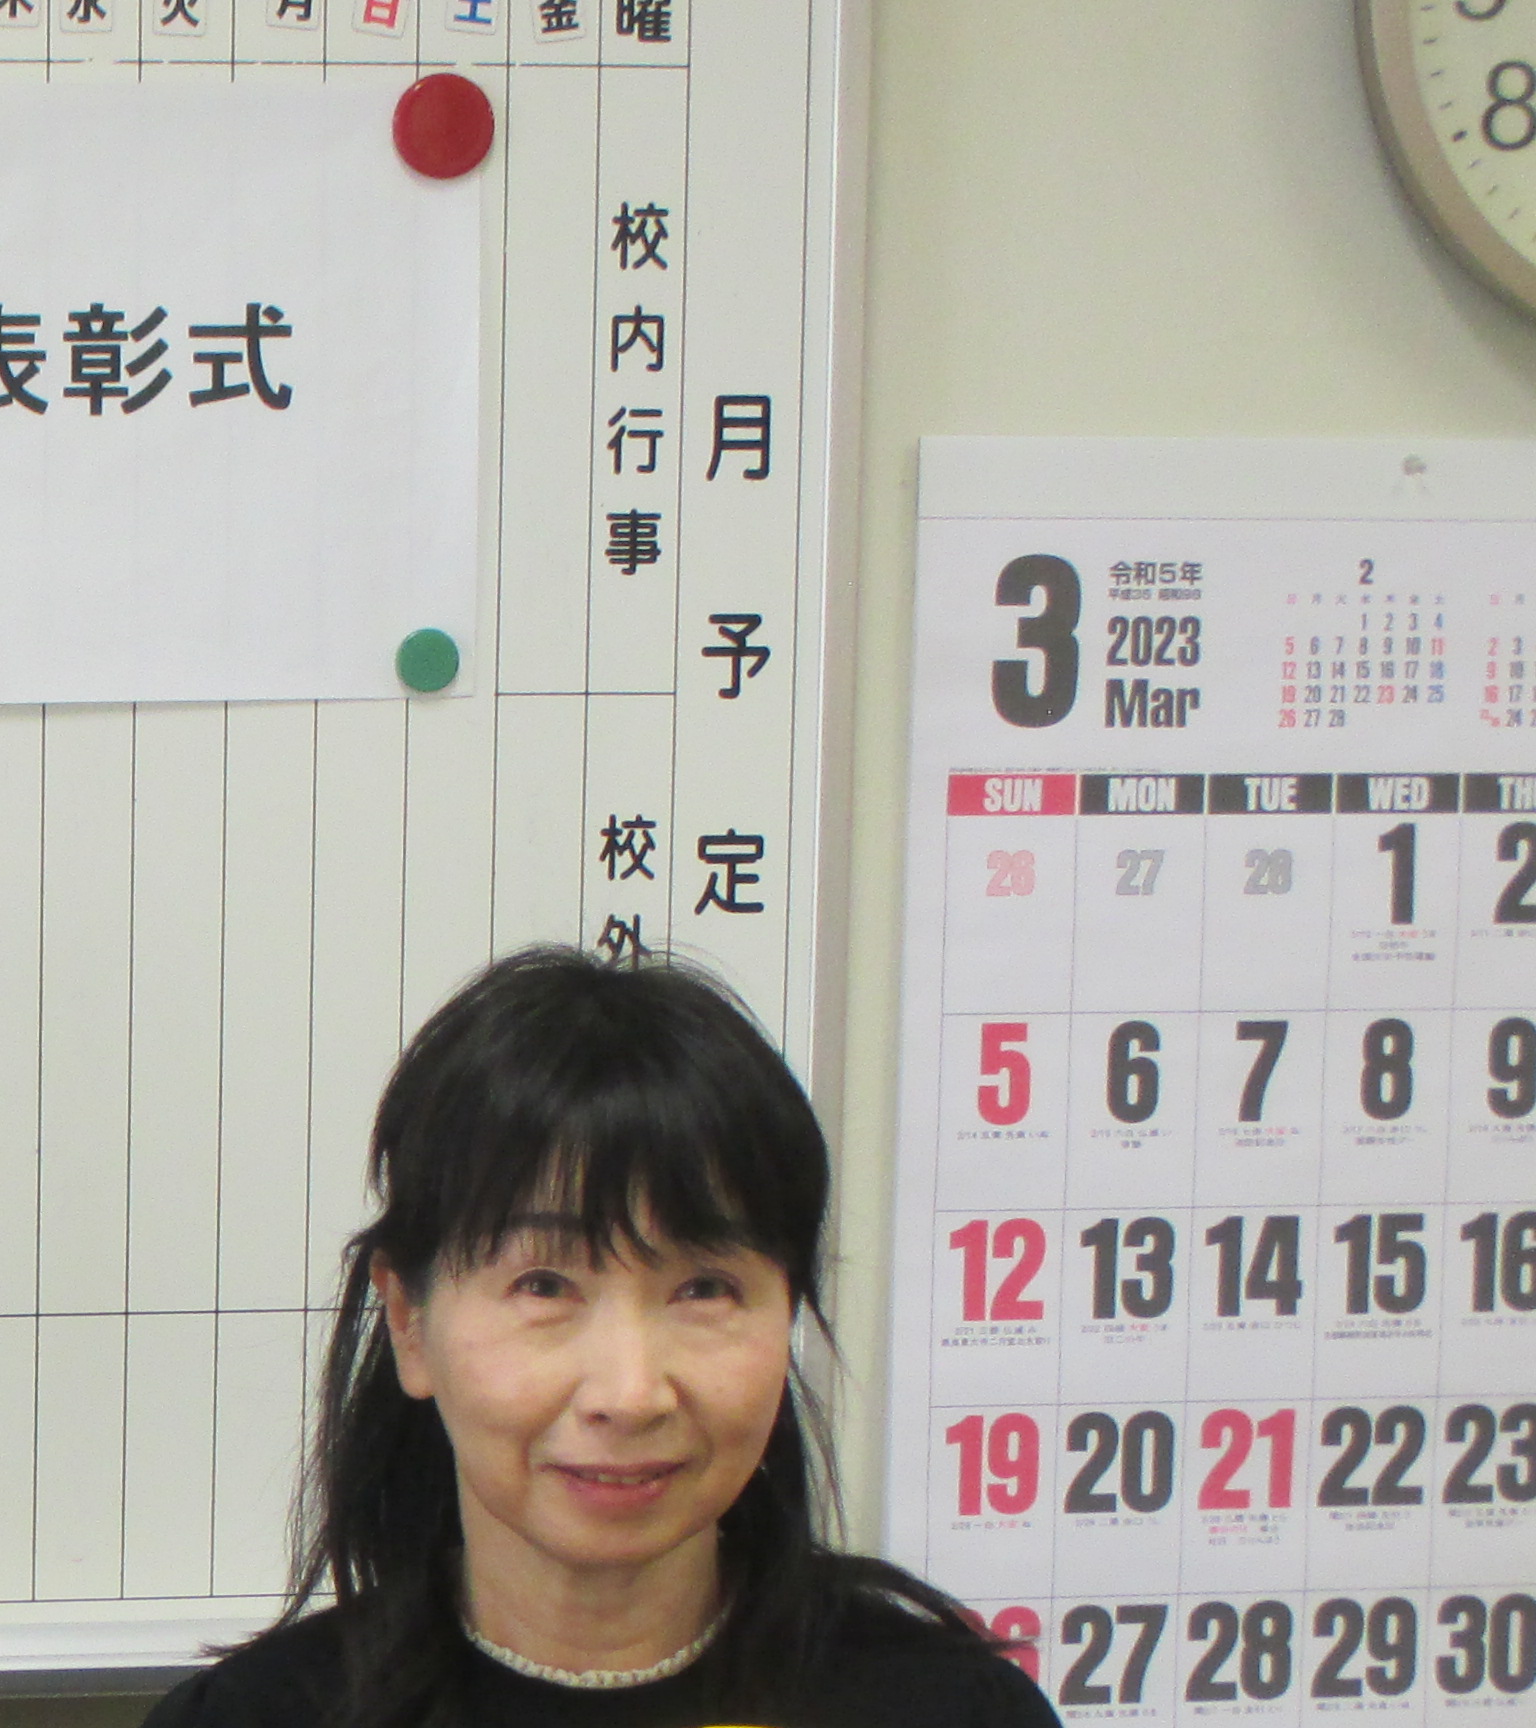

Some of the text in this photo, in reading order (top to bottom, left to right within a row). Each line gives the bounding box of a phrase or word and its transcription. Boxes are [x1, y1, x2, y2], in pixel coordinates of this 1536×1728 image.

[1481, 61, 1536, 151] 8
[604, 201, 669, 576] 校内行事
[1109, 560, 1203, 587] 令和5年
[1359, 558, 1374, 585] 2
[694, 394, 772, 915] 月予定
[992, 554, 1082, 728] 3
[1106, 615, 1201, 667] 2023
[1105, 678, 1201, 728] Mar
[983, 776, 1536, 813] SUN MON TUE WED TH
[985, 822, 1536, 924] 26 27 28 1 2
[978, 1018, 1536, 1125] 5 6 7 8 9
[951, 1211, 1536, 1321] 12 13 14 15 16
[948, 1404, 1536, 1516] 19 20 21 22 23
[1059, 1595, 1536, 1705] 27 28 29 30
